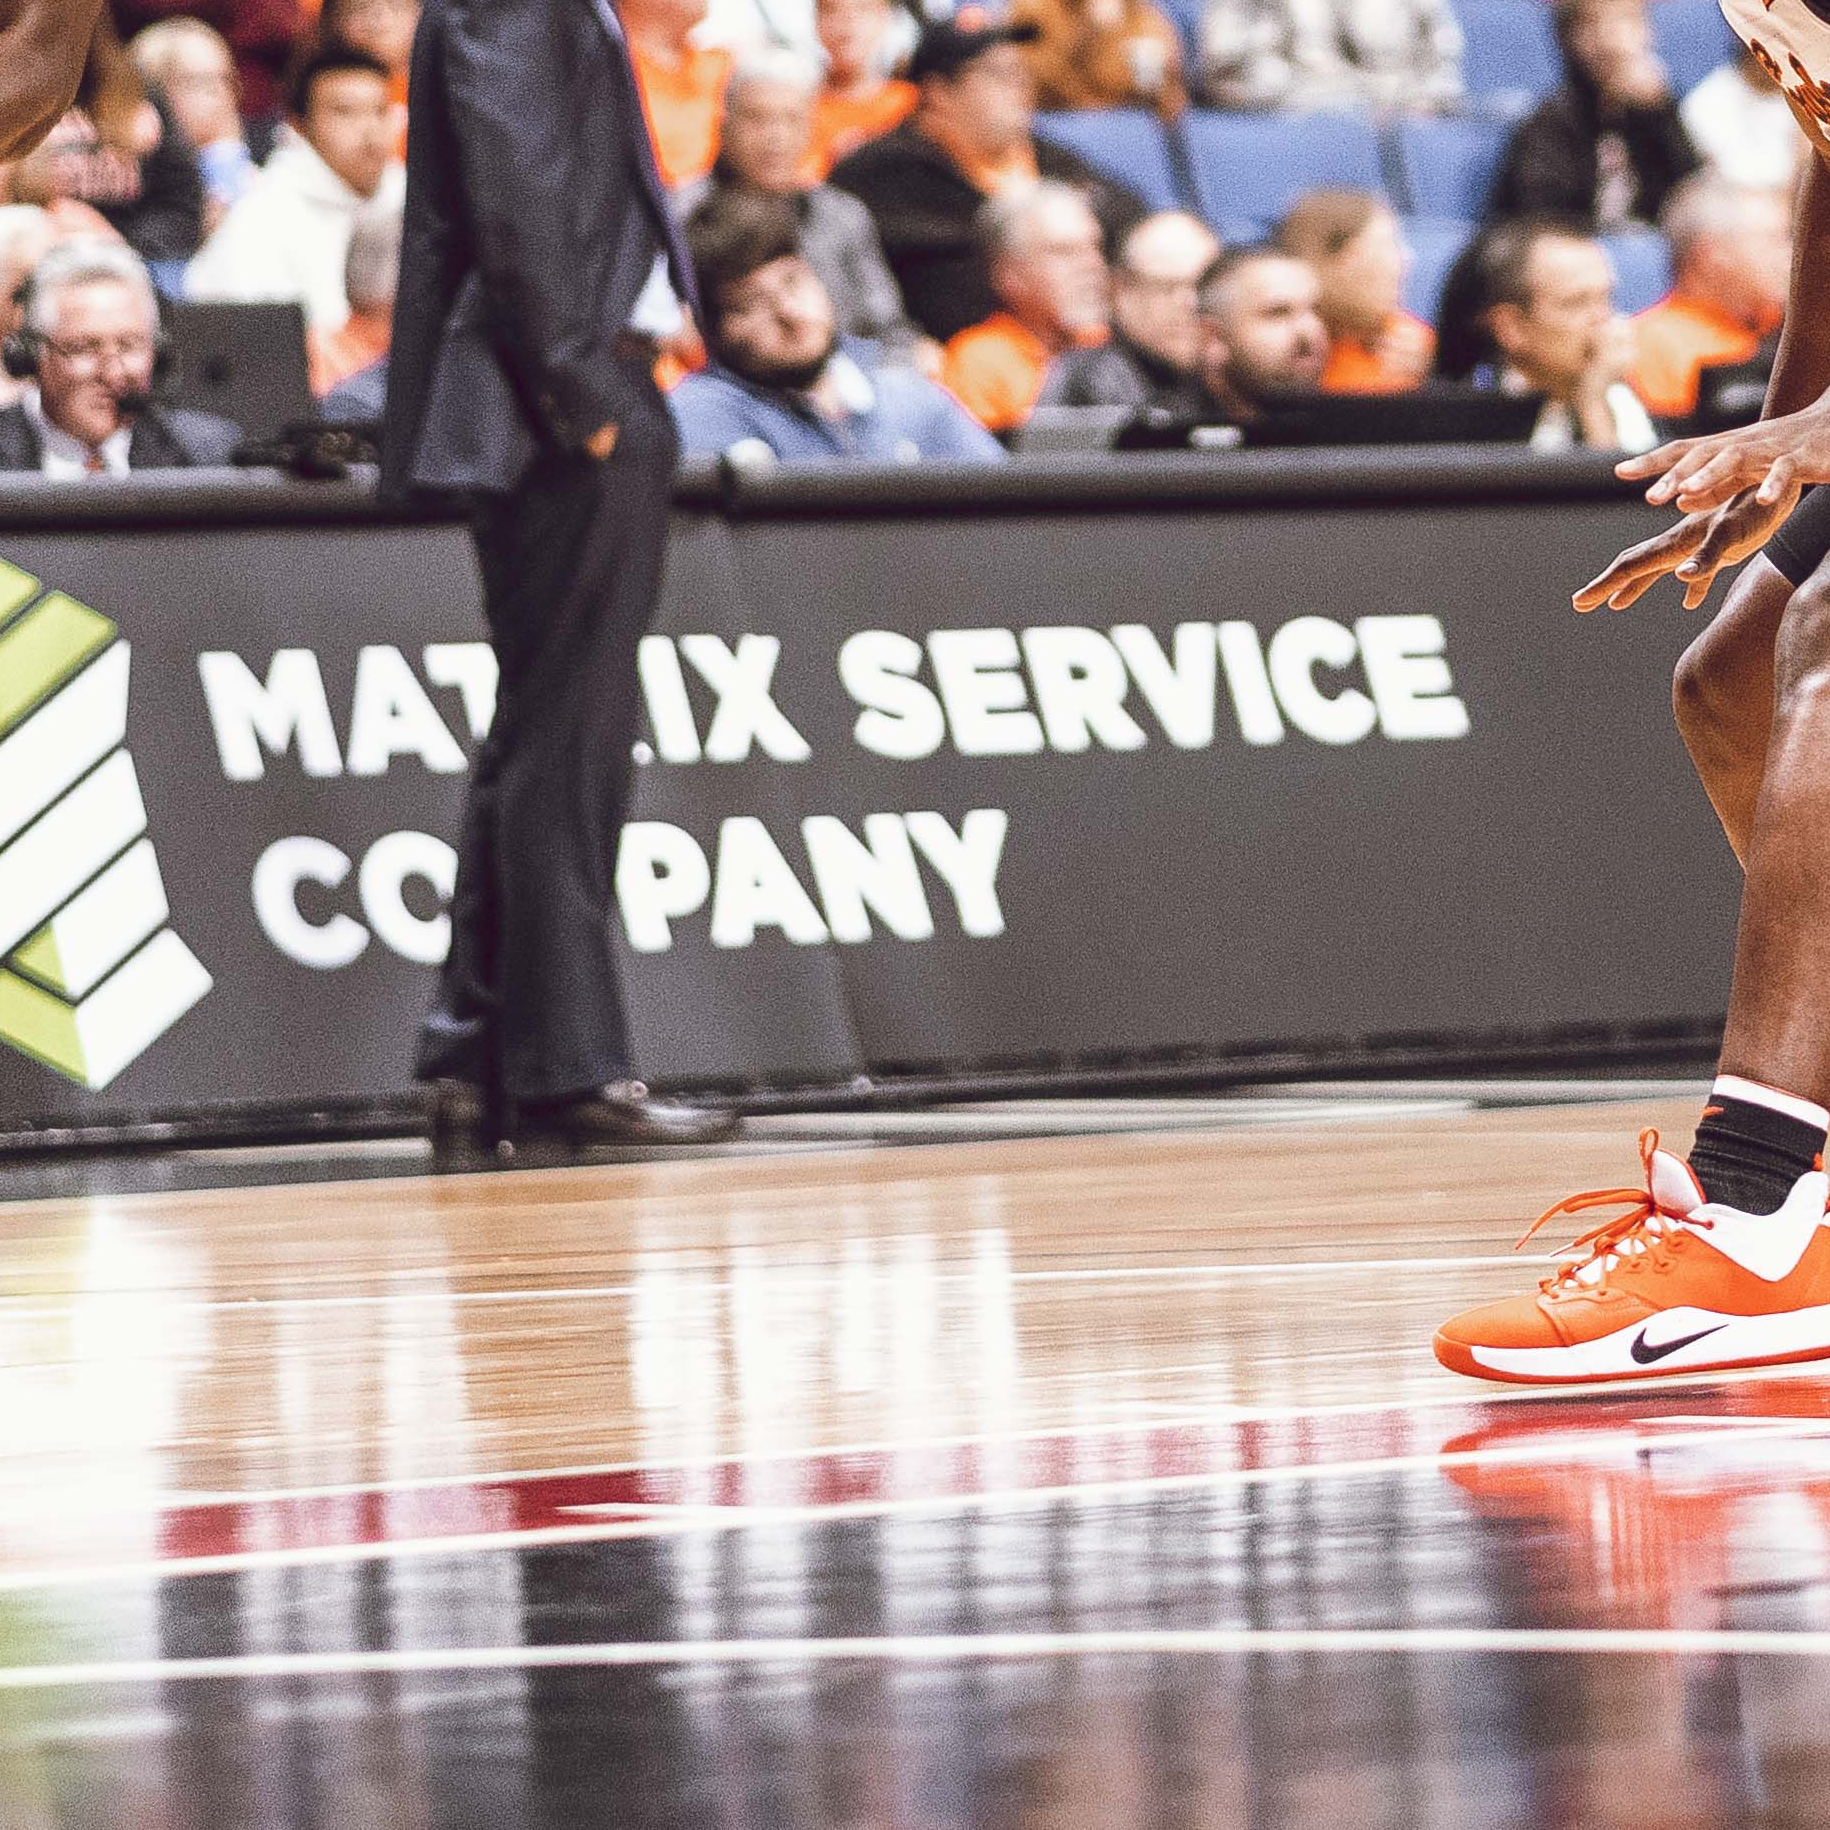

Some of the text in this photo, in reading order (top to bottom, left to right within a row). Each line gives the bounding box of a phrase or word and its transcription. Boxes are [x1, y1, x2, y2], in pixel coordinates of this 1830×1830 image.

[198, 614, 1472, 780] MATIX SERVICE
[251, 808, 1008, 969] COPANY
